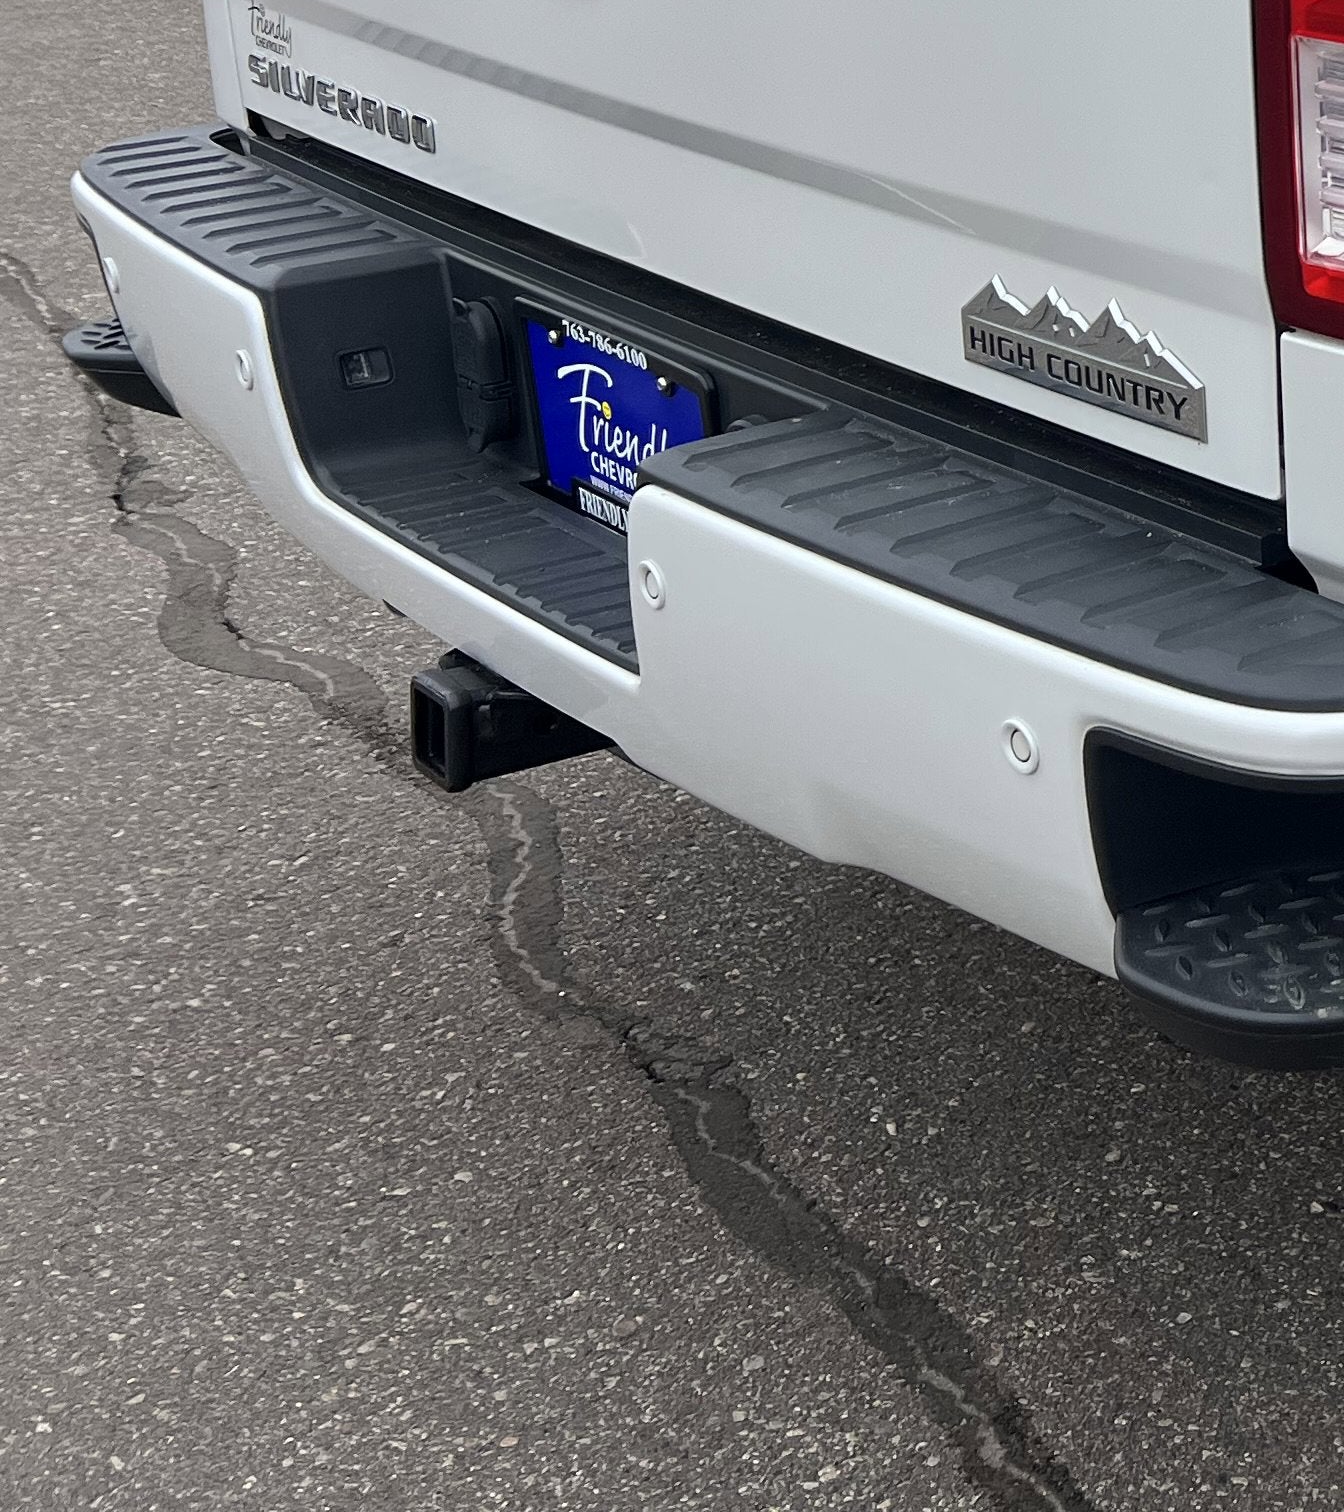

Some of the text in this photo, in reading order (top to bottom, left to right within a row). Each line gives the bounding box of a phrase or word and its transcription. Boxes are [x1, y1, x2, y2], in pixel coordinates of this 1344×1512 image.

[248, 53, 438, 154] SILVERADO
[562, 319, 647, 370] 763-786-6100
[969, 326, 1188, 420] HIGH COUNTRY
